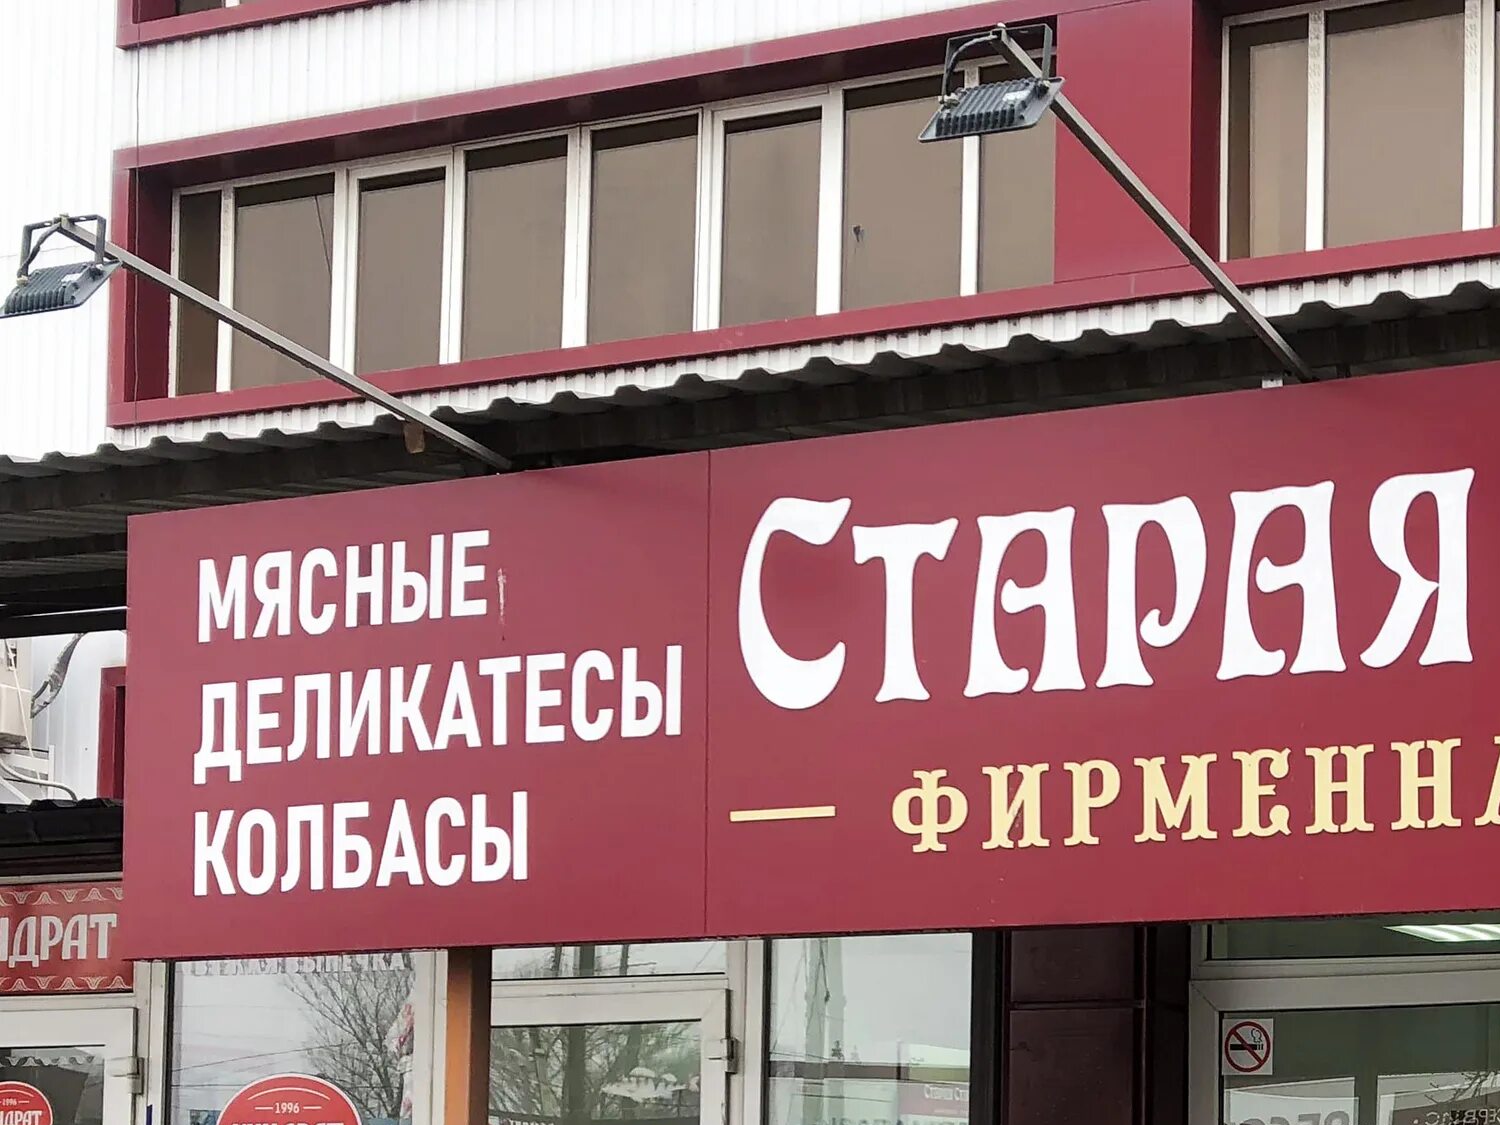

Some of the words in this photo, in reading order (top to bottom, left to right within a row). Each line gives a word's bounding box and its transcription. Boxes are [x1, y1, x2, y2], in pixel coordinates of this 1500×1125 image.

[199, 530, 489, 642] МЯСНЫЕ
[194, 645, 682, 784] ДЕЛИКАТЕСЫ
[194, 791, 527, 896] КОЛБАСЫ
[0, 914, 118, 969] ДРАТ
[274, 1102, 300, 1114] 1996
